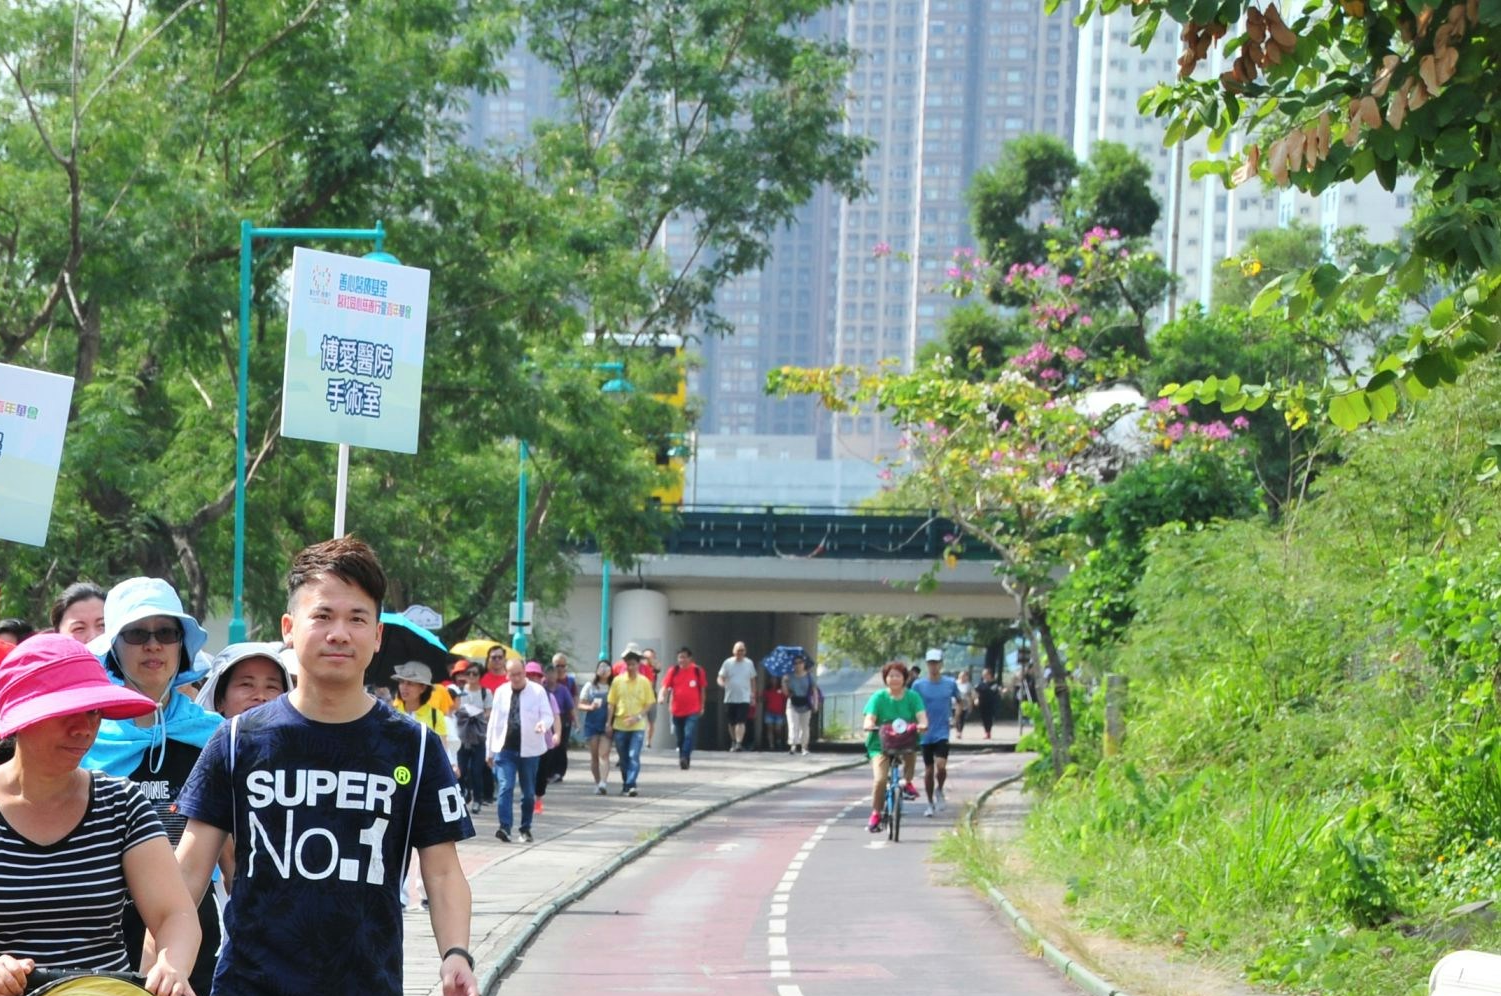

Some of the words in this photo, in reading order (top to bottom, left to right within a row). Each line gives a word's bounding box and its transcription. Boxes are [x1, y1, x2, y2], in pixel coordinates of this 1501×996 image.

[321, 334, 393, 380] 博愛醫院
[326, 378, 382, 418] 手術室
[246, 769, 397, 814] SUPER
[247, 809, 390, 886] No.1
